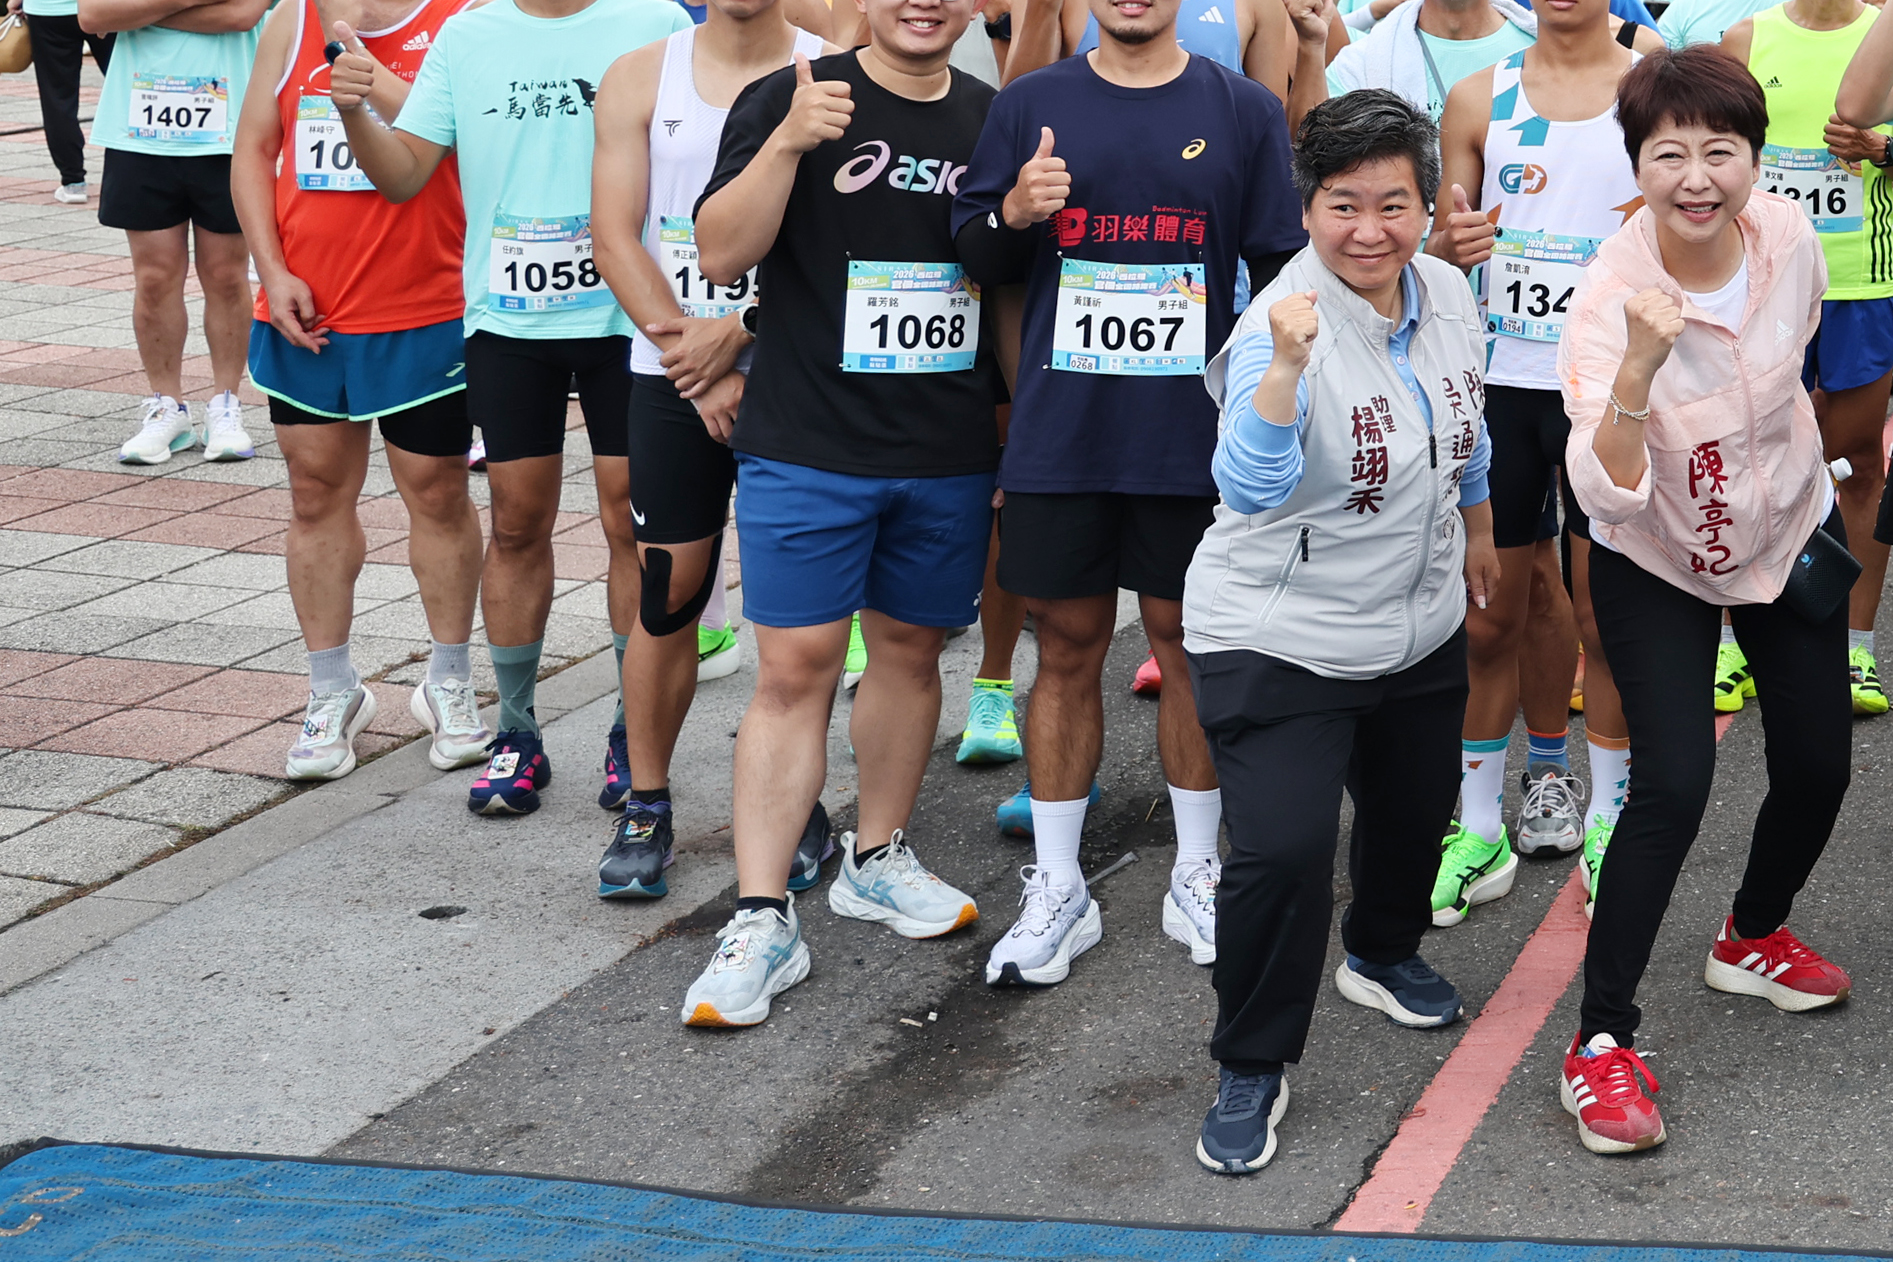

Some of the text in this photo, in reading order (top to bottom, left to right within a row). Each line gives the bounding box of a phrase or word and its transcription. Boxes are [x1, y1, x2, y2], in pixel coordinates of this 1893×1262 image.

[508, 79, 568, 92] Taiwan
[481, 92, 579, 120] 一馬當先
[142, 104, 212, 128] 1407
[309, 139, 361, 171] 10
[1825, 174, 1849, 183] 男子組
[1091, 214, 1208, 246] 羽樂體育
[574, 244, 592, 254] 男子
[1495, 242, 1514, 251] 10KM
[1526, 239, 1545, 249] 2026
[504, 258, 601, 293] 1058
[893, 270, 914, 279] 2026
[1063, 274, 1084, 284] 10KM
[1096, 271, 1116, 280] 2026
[851, 276, 878, 287] 10KM
[867, 297, 970, 308] 羅芳銘 男子組
[1506, 279, 1575, 318] 134
[1158, 300, 1188, 310] 男子組
[870, 313, 966, 350] 1068
[1075, 314, 1184, 352] 1067
[1502, 322, 1521, 333] 0194
[1071, 359, 1094, 371] 0268
[1371, 394, 1397, 434] 助理
[1343, 405, 1389, 515] 楊翊禾
